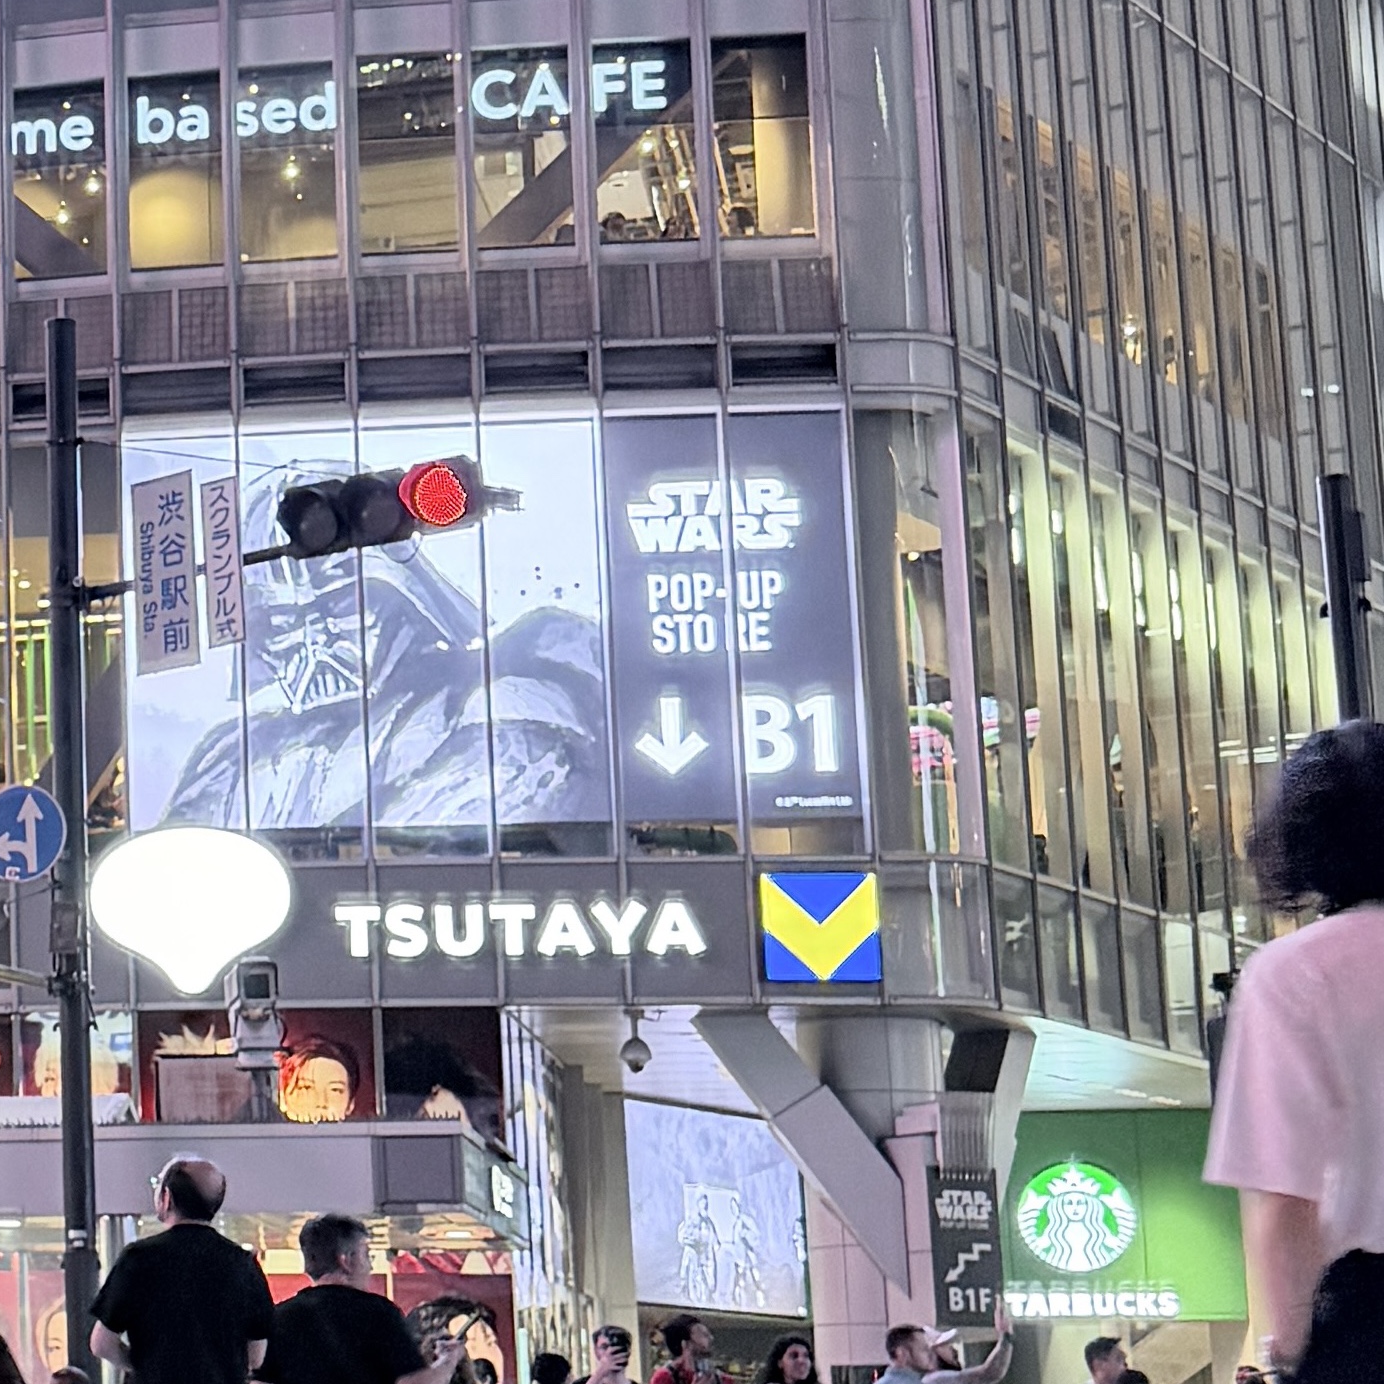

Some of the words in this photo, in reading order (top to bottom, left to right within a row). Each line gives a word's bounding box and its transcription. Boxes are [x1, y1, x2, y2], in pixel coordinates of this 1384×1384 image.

[136, 82, 338, 142] based
[471, 61, 667, 120] CAFE
[627, 478, 800, 518] STAR
[140, 521, 155, 595] Shibuya
[157, 490, 190, 654] 渋谷駅前
[208, 485, 237, 638] スクランブル式
[647, 570, 783, 613] POP-UP
[143, 601, 158, 639] Sta.
[652, 612, 773, 654] STORE
[743, 694, 839, 773] B1
[333, 900, 708, 958] TSUTAYA
[935, 1189, 992, 1206] STAR
[935, 1205, 992, 1220] WARS
[949, 1287, 991, 1312] B1F
[997, 1292, 1181, 1317] TARBUCKS
